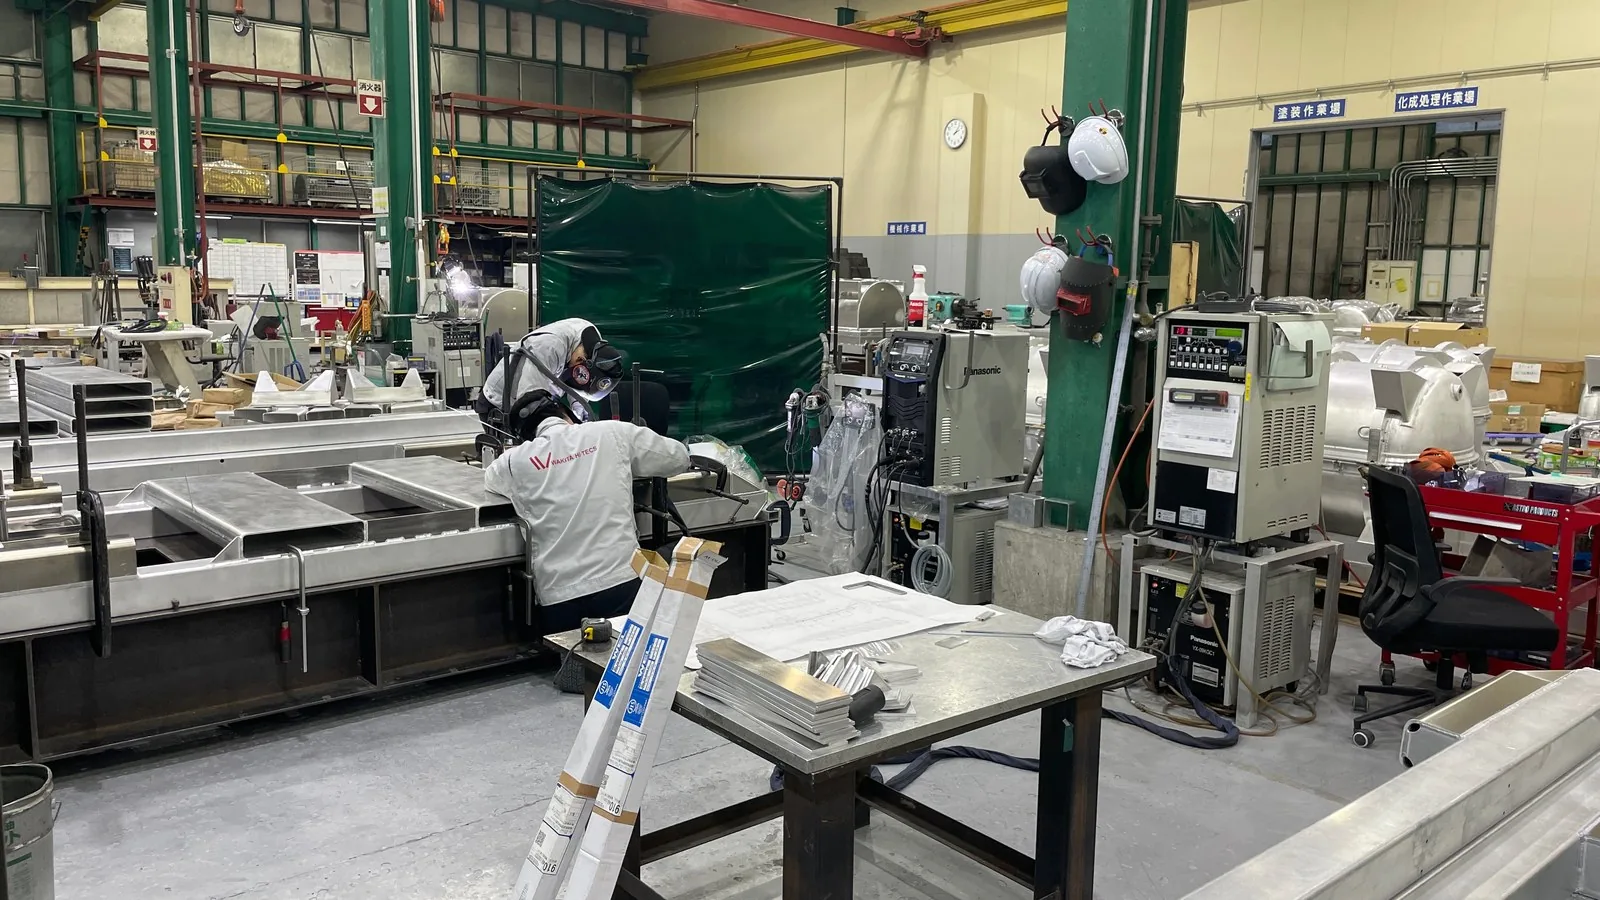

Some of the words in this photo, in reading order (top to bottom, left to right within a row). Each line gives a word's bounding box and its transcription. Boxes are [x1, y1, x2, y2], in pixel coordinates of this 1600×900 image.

[359, 83, 381, 92] 消火器
[1397, 90, 1475, 109] 化成処理作業場
[1277, 102, 1341, 120] 塗装作業場
[551, 455, 574, 466] WAKITA
[1530, 506, 1559, 518] PRODUCTS
[1189, 634, 1219, 648] Panasonic
